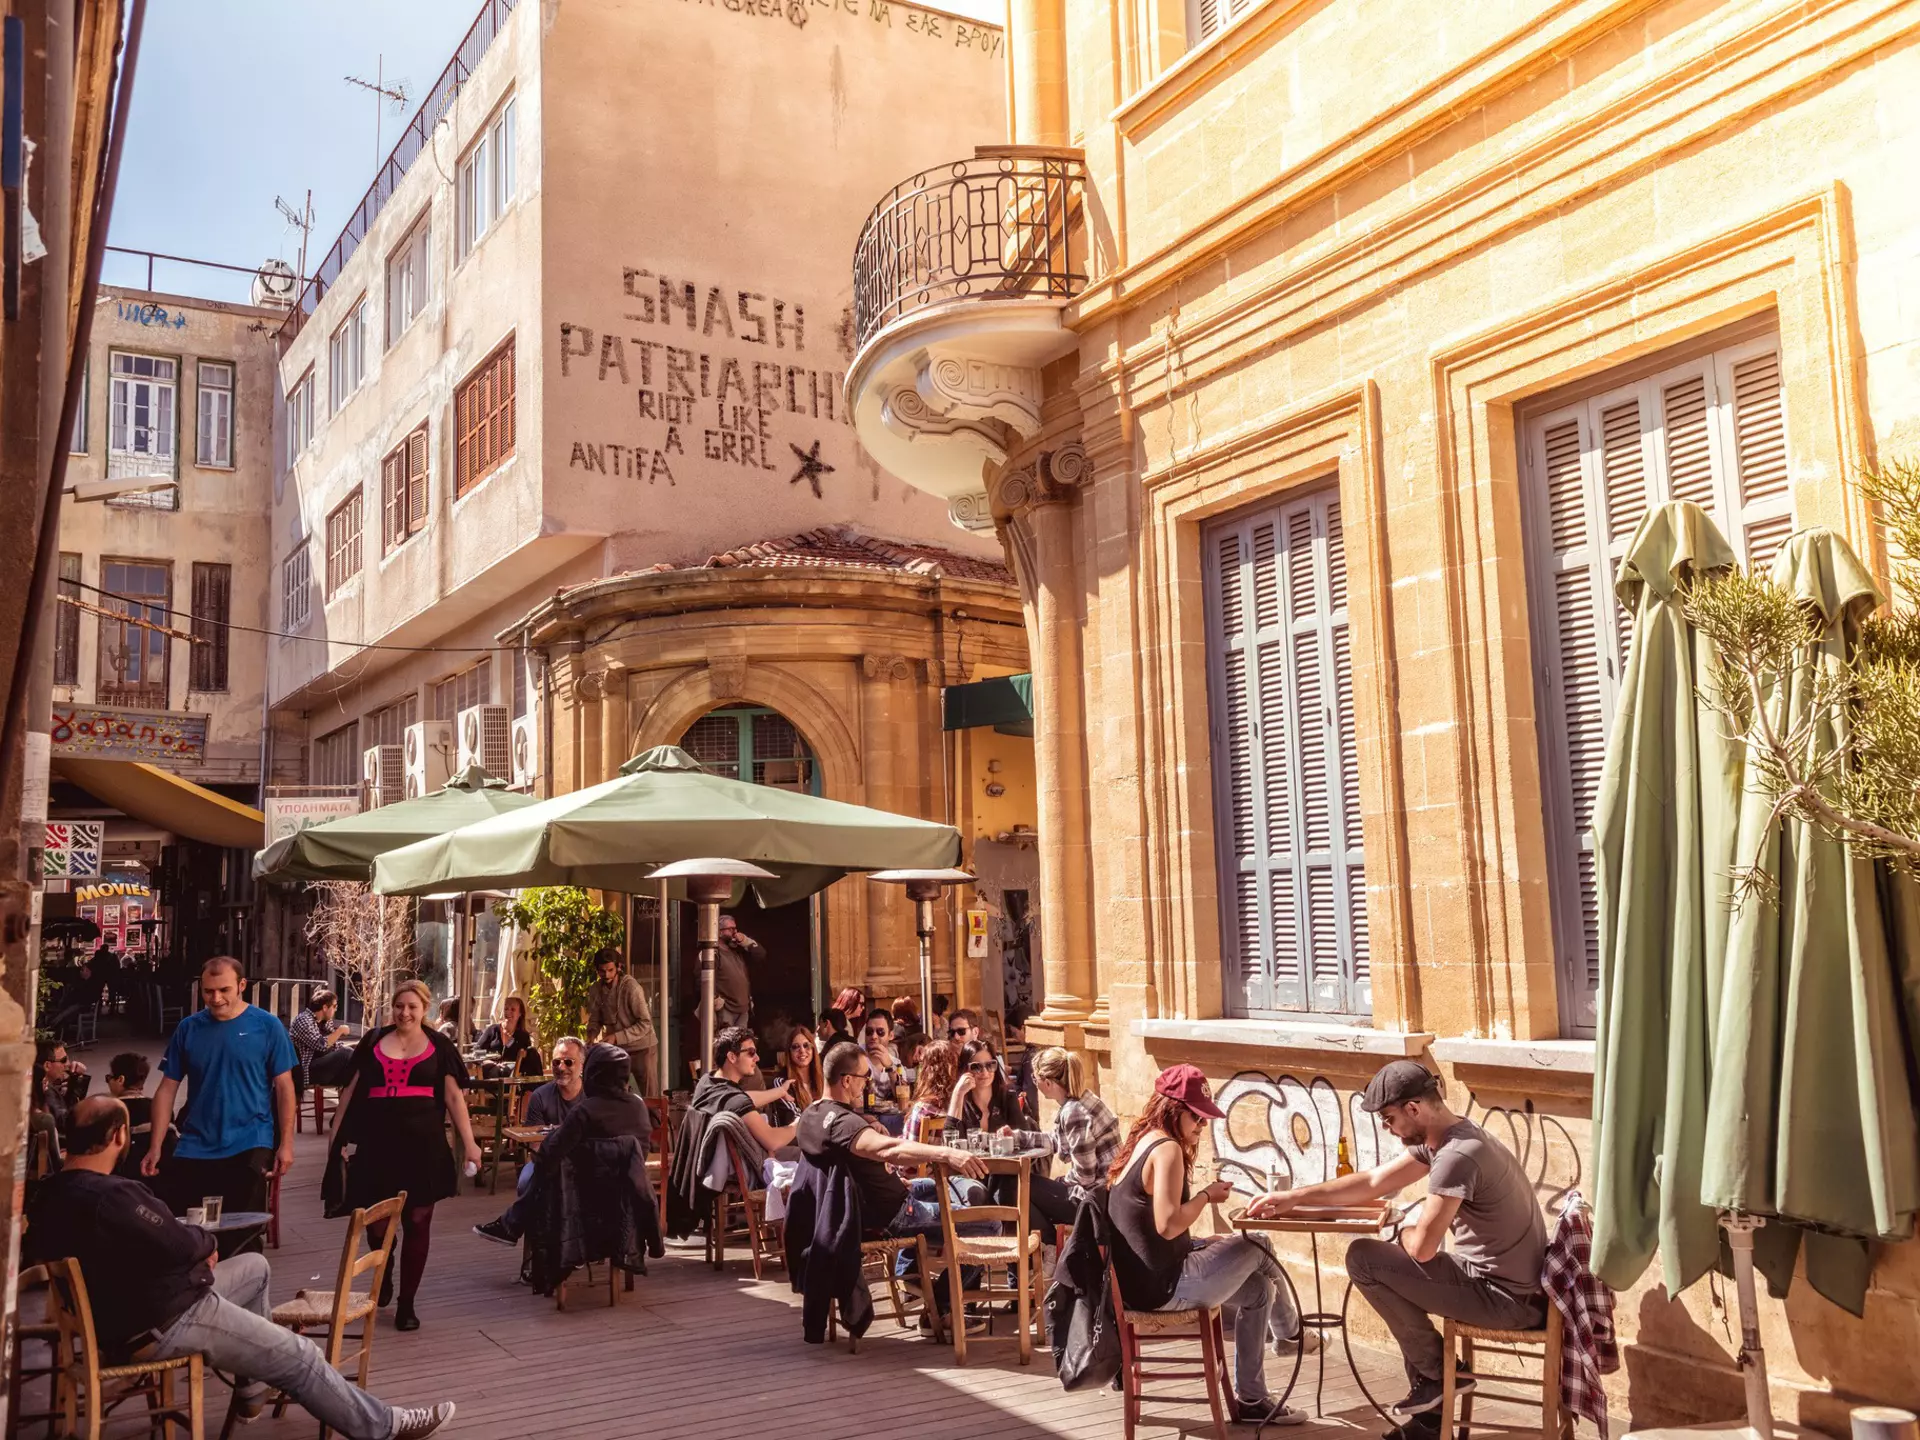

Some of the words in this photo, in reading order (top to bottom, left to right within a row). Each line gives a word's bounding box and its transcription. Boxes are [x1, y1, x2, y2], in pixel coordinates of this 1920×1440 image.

[622, 265, 805, 351] SMASH
[638, 388, 699, 425] RIOT
[718, 402, 773, 440] LIKE
[665, 425, 685, 455] A
[704, 428, 777, 472] GRRL
[277, 801, 352, 815] ΥΠΟΔΗΜΑΤΑ
[76, 881, 151, 903] MOVIES
